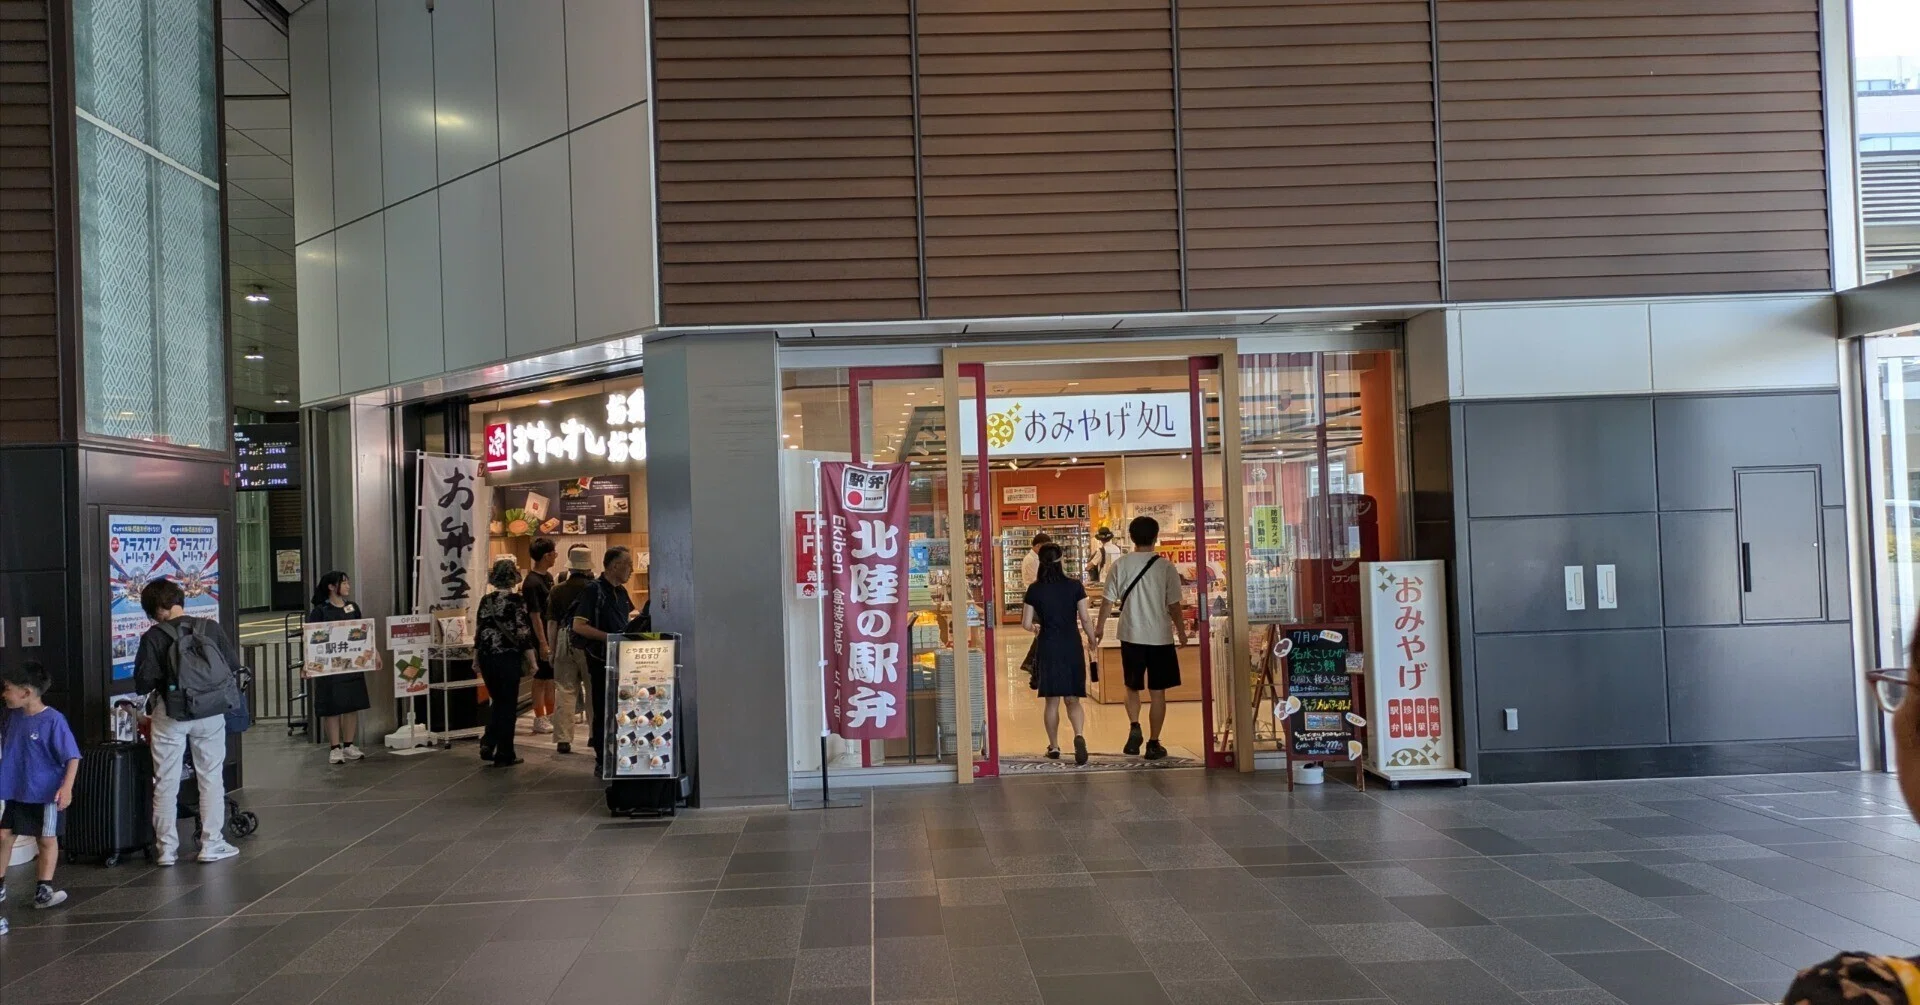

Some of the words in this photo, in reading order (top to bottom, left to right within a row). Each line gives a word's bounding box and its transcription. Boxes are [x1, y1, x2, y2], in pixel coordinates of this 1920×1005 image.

[1024, 400, 1176, 443] おみやげ処
[849, 472, 884, 489] 駅弁
[1020, 504, 1090, 521] 7-ELEVE
[437, 467, 475, 600] お弁当
[1257, 519, 1266, 544] 作動中
[1270, 509, 1278, 546] 防犯カメラ
[120, 538, 161, 551] プラスワン
[125, 552, 149, 563] トリップ
[177, 538, 212, 551] プラスワン
[832, 515, 846, 574] Ekiben
[401, 616, 420, 624] OPEN
[846, 520, 899, 728] 北陸の駅弁
[1394, 576, 1428, 691] おみやげ
[625, 646, 669, 654] とやまをむすぶ
[1389, 705, 1400, 731] 駅弁
[1403, 705, 1413, 731] 珍味
[1416, 705, 1426, 731] 銘菓
[1429, 704, 1440, 730] 地酒
